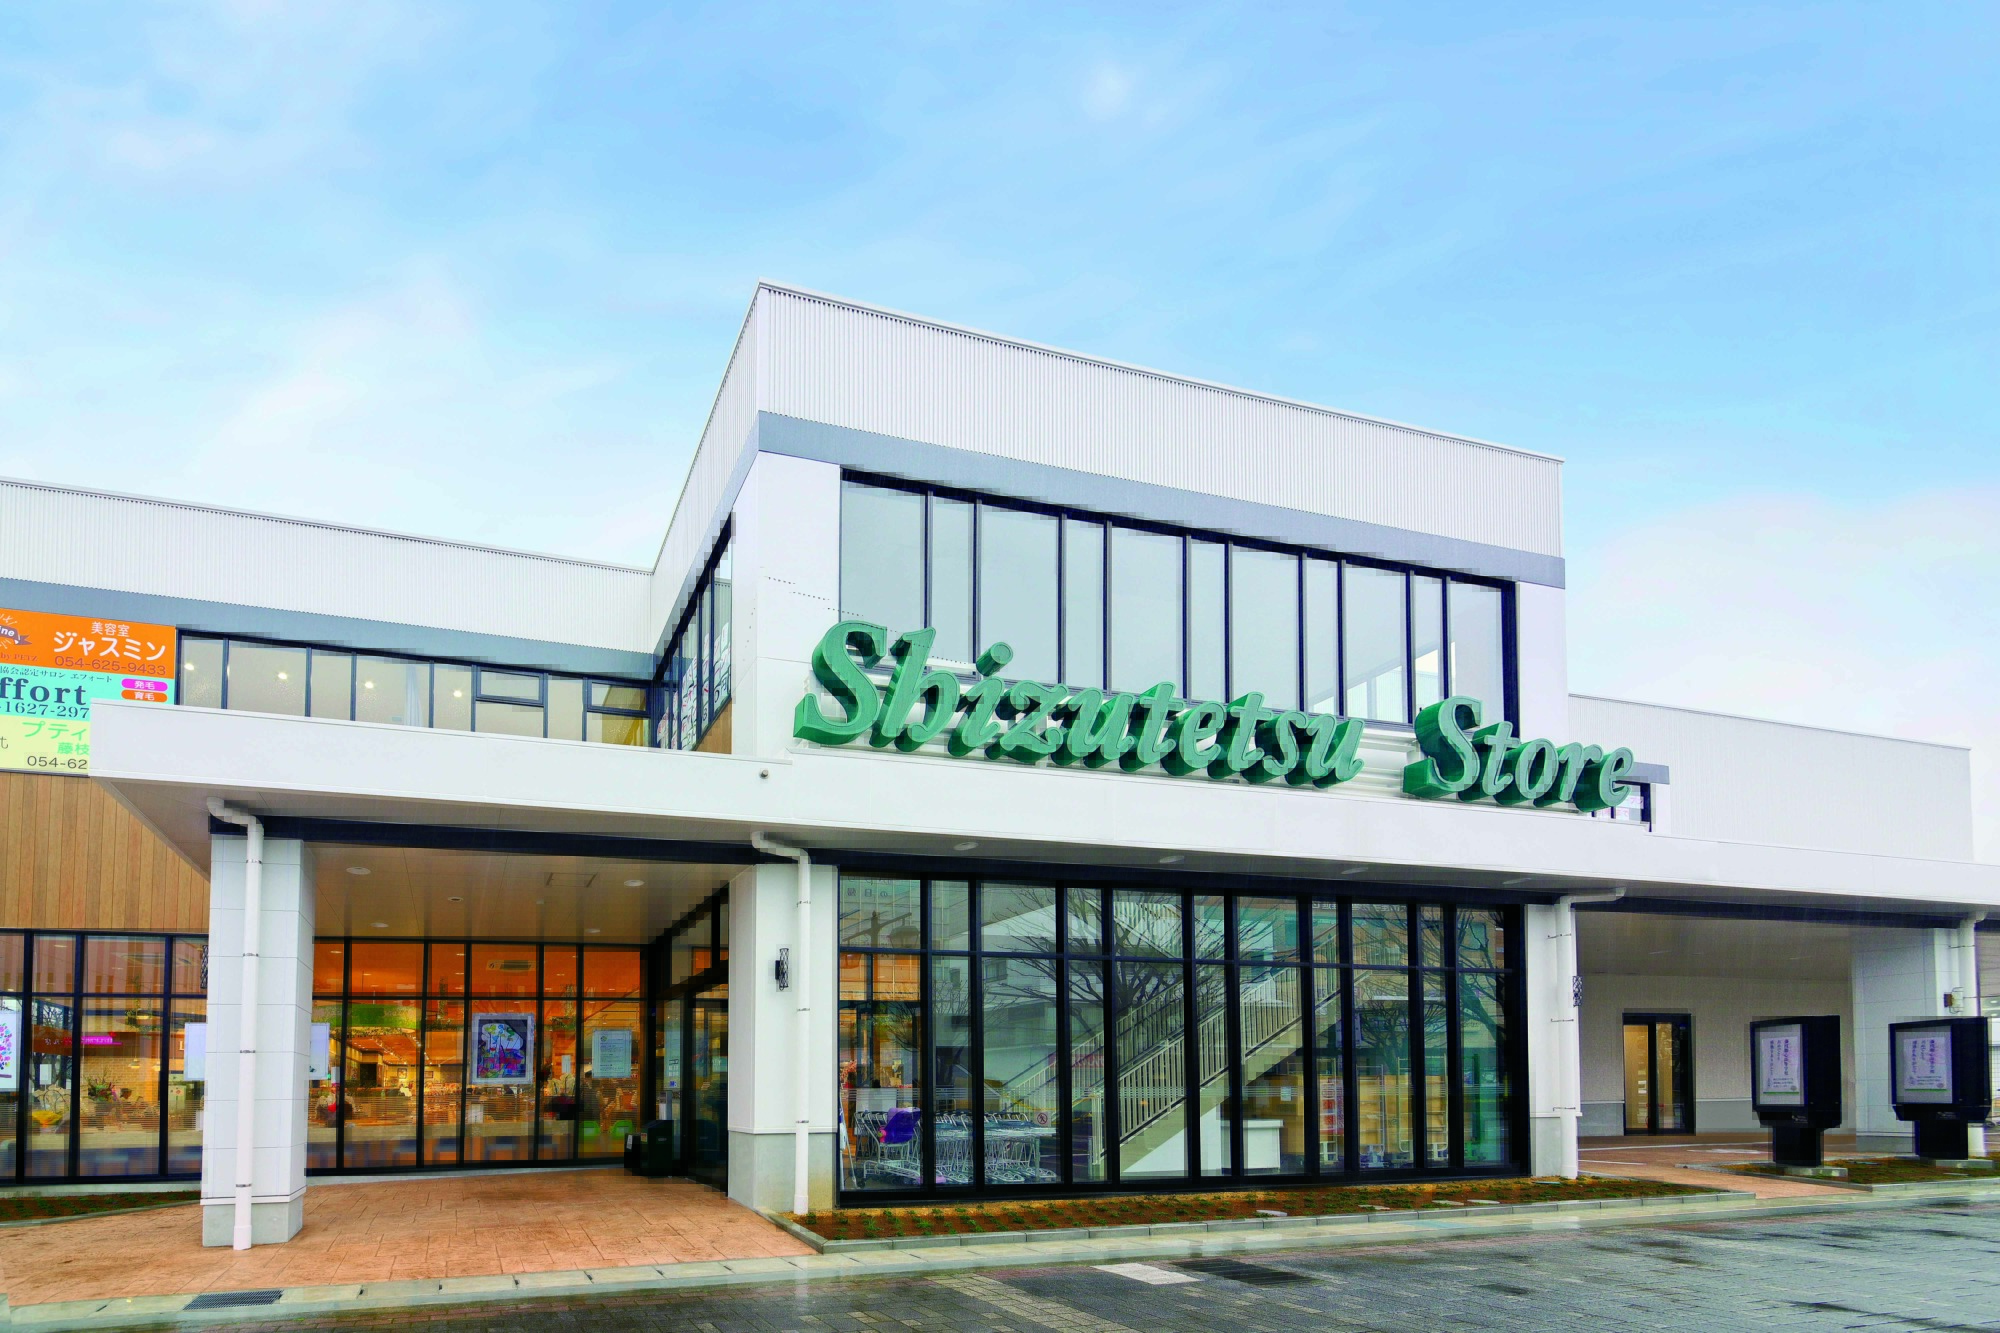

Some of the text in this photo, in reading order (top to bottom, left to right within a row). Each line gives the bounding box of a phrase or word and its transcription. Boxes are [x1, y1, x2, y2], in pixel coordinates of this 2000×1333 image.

[91, 621, 130, 637] 美容室
[53, 631, 166, 661] ジャスミン
[54, 655, 166, 676] 054-625-9433
[134, 680, 155, 690] 発毛
[134, 691, 155, 701] 育毛
[0, 701, 90, 719] 1627-297
[793, 620, 1365, 789] Shizutetsu
[1403, 695, 1634, 813] Store
[22, 720, 87, 741] プティ
[57, 742, 90, 756] 藤枝
[27, 755, 88, 770] 054-62
